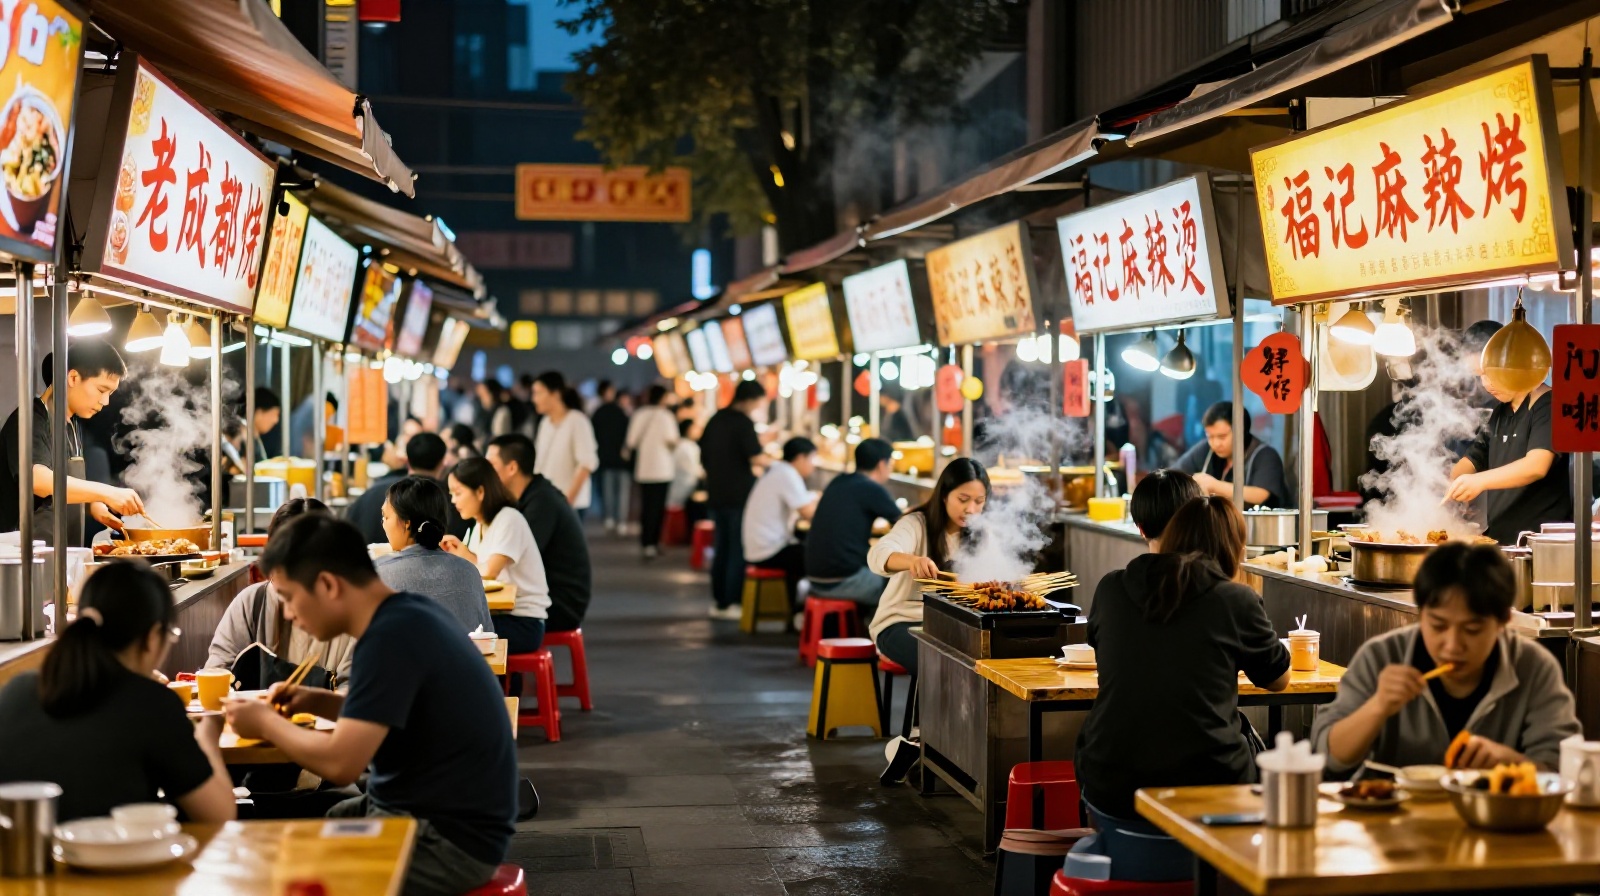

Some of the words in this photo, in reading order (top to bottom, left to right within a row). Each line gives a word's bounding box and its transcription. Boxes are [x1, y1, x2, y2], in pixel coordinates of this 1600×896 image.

[135, 116, 263, 288] 老成都烧
[1070, 200, 1206, 306] 福记麻辣烫
[1281, 113, 1527, 260] 福记麻辣烤
